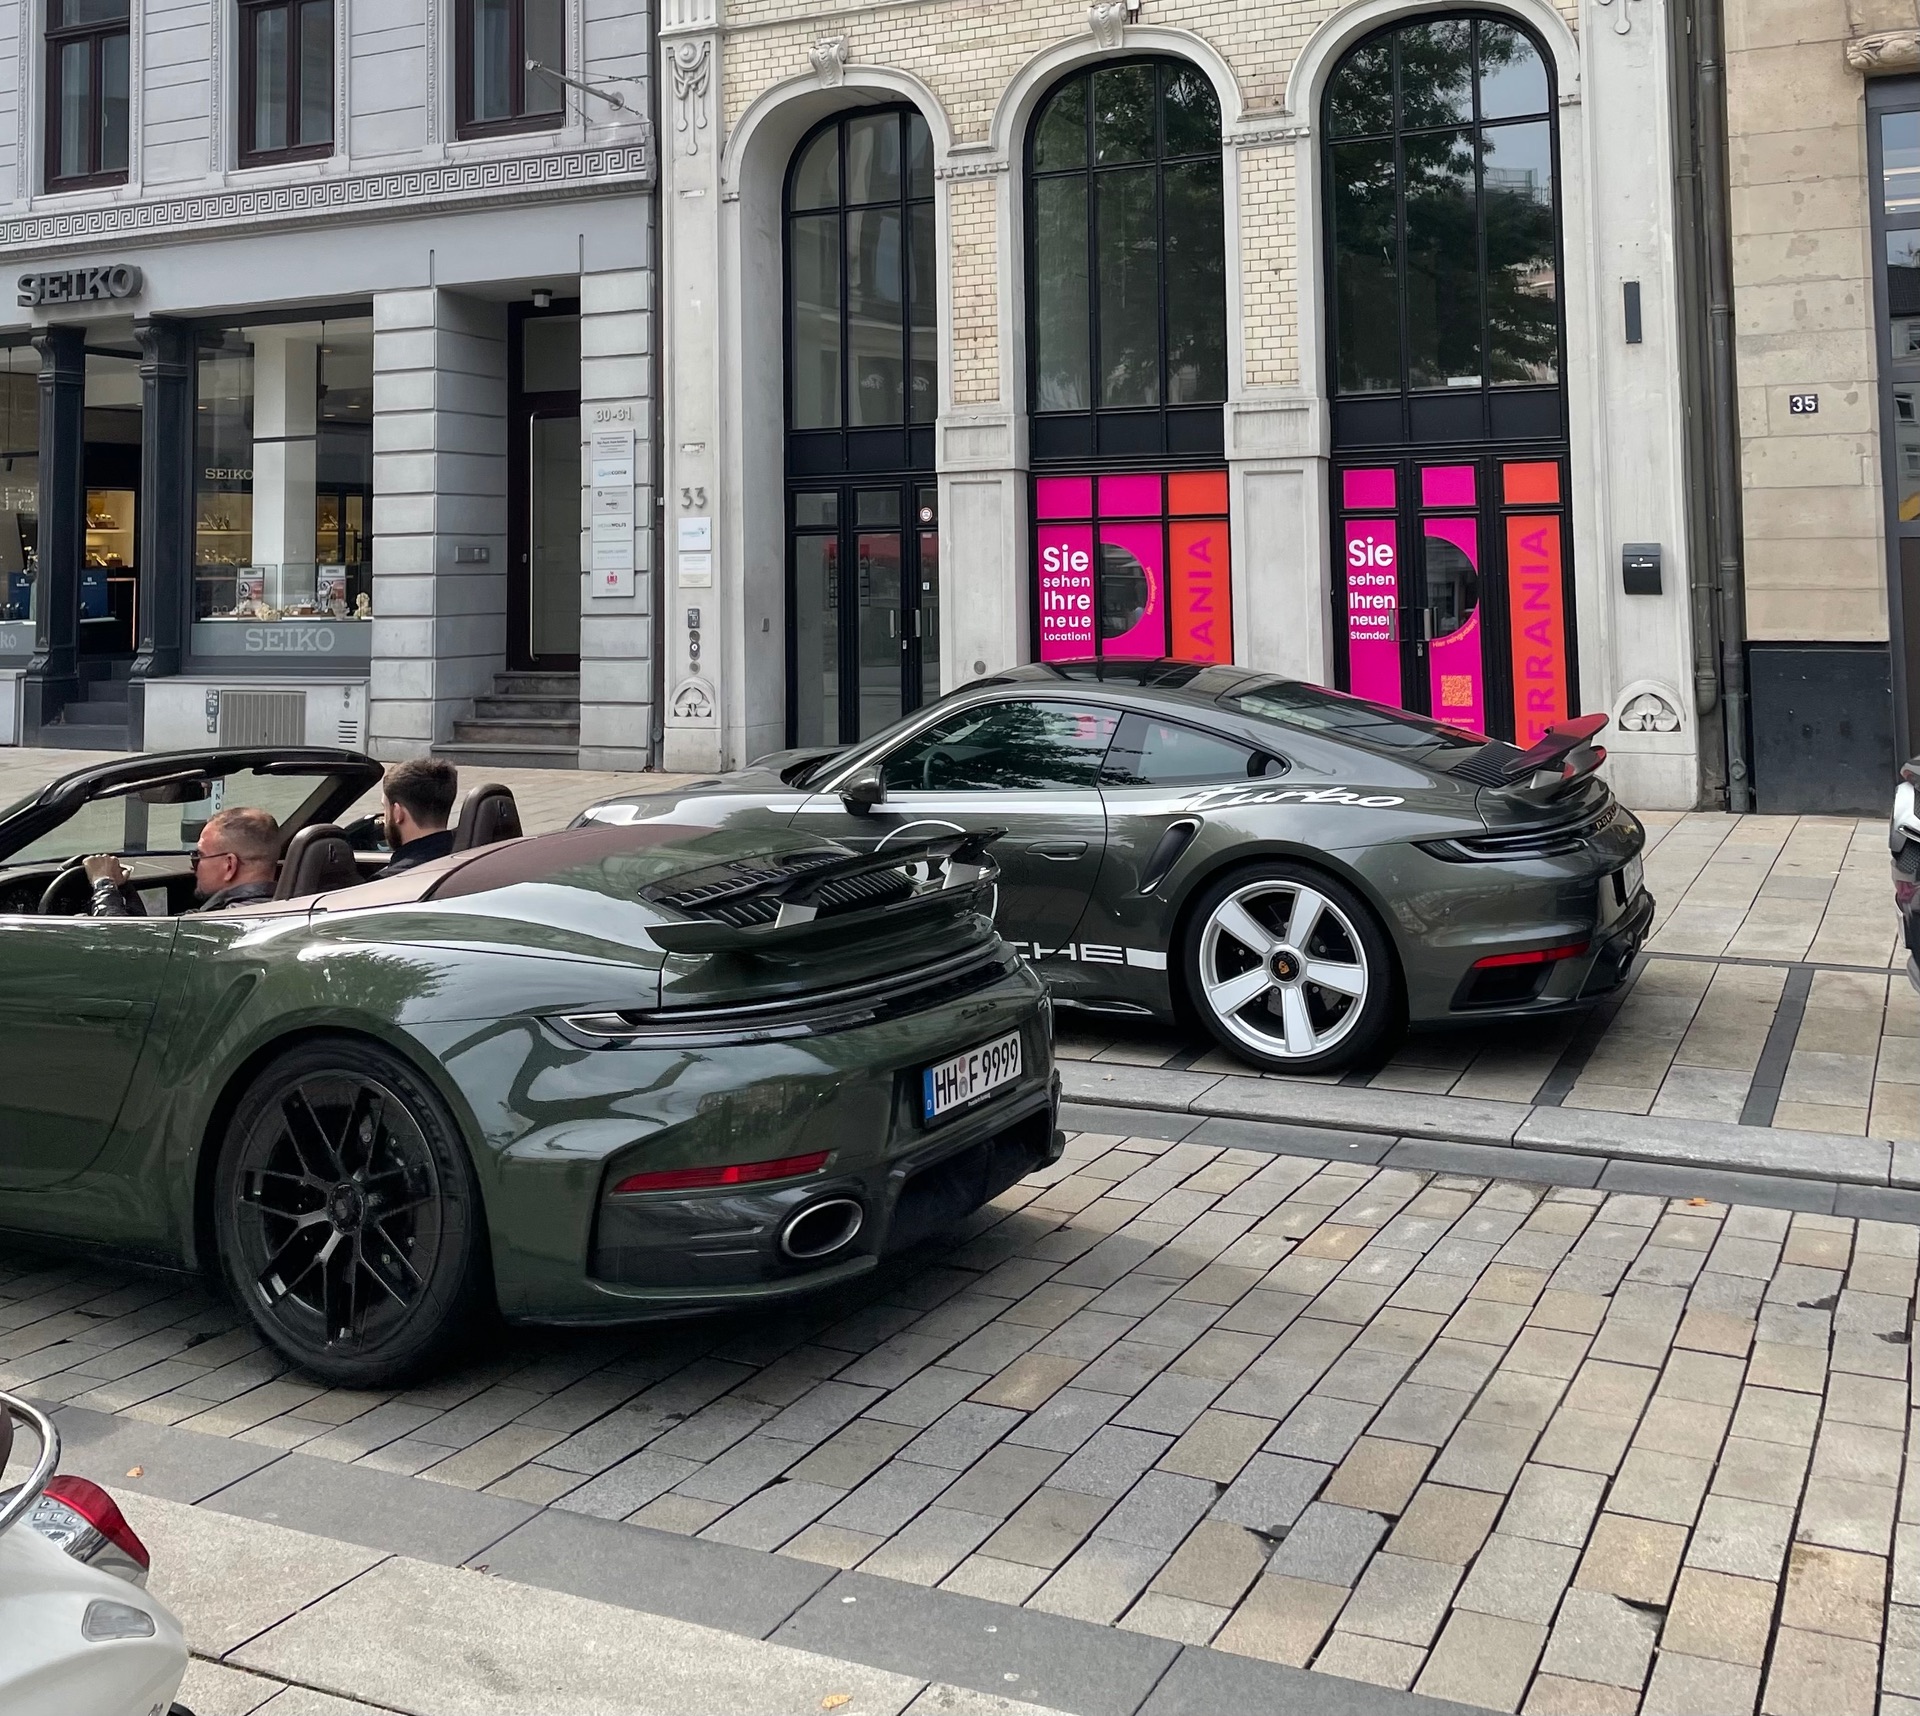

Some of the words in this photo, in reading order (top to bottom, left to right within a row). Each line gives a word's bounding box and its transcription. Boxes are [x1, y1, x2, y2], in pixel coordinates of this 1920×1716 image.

[17, 264, 142, 306] SEIKO
[1792, 396, 1816, 412] 35
[596, 406, 632, 422] 30-31
[205, 468, 253, 480] SEIKO
[681, 487, 707, 510] 33
[1043, 544, 1089, 572] Sie
[1348, 536, 1394, 567] Sie
[1043, 575, 1091, 588] sehen
[1348, 572, 1395, 586] sehen
[1044, 590, 1091, 611] Ihre
[1349, 591, 1396, 609] Ihren
[1044, 615, 1092, 628] neue
[245, 628, 335, 651] SEIKO
[1044, 632, 1091, 642] Location!
[1350, 630, 1390, 640] Standor
[1183, 786, 1405, 812] turbo
[935, 1063, 958, 1109] HH
[968, 1054, 979, 1093] F
[982, 1038, 1018, 1086] 9999
